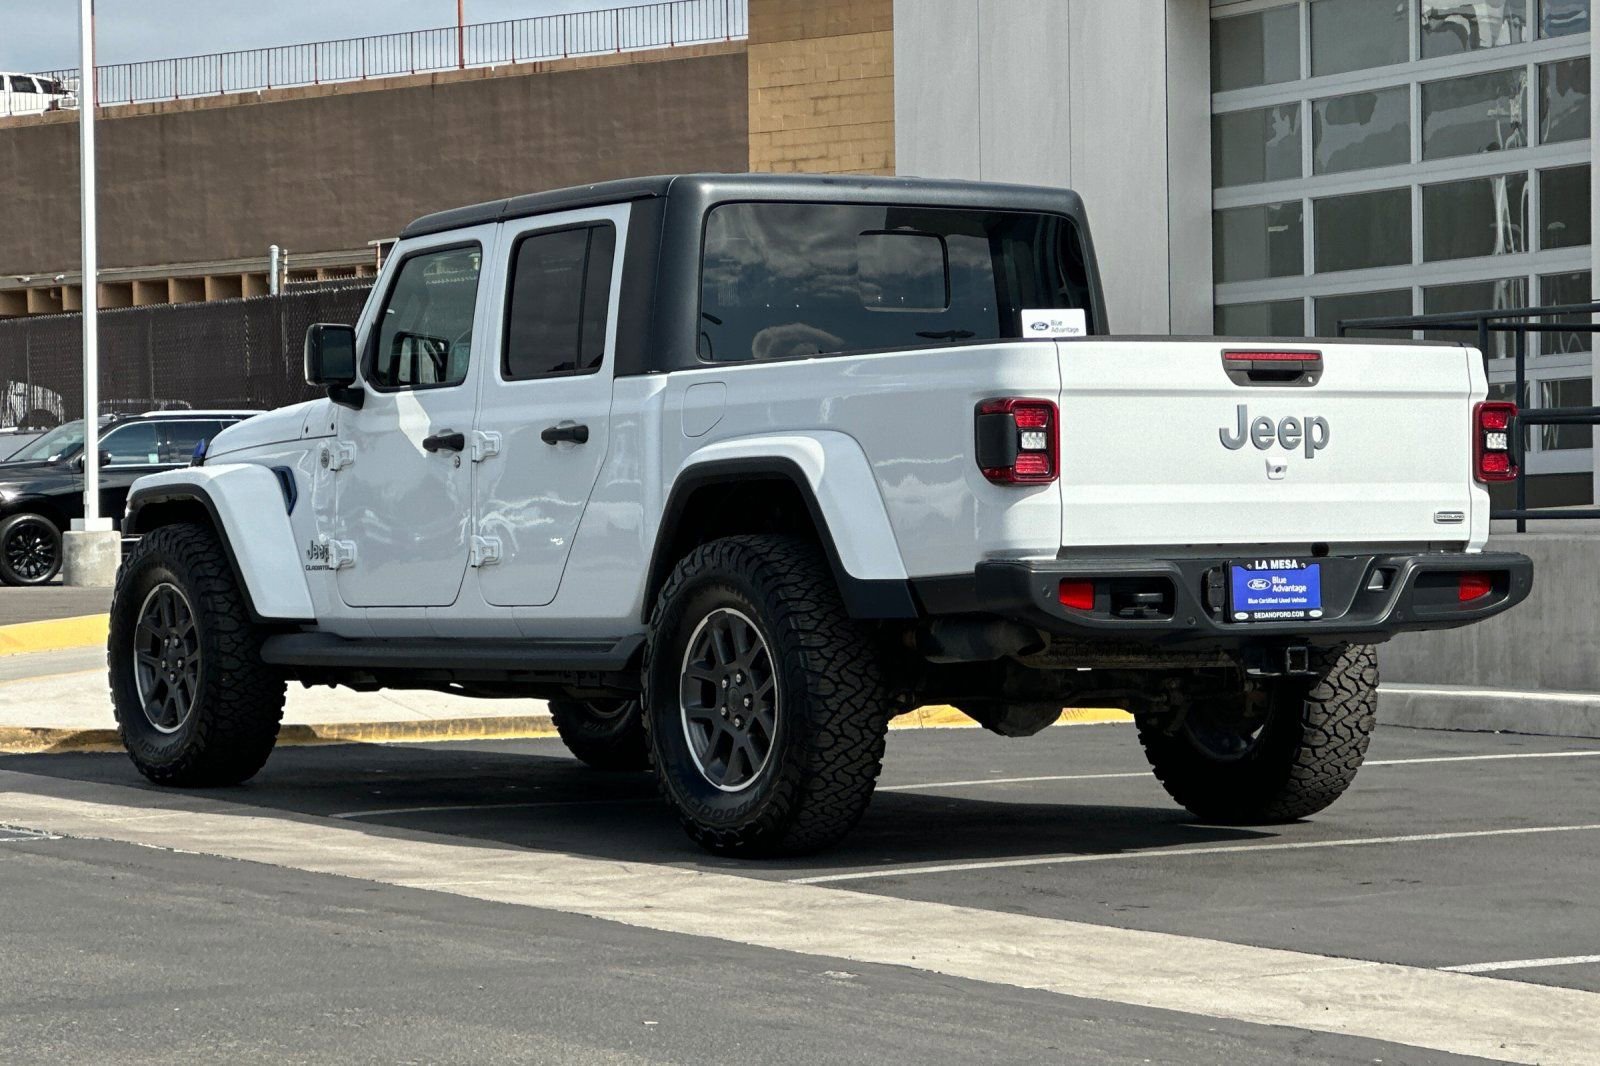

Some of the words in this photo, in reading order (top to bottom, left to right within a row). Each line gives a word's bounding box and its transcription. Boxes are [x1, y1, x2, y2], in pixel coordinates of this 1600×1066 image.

[1219, 404, 1330, 459] Jeep
[1255, 560, 1268, 570] LA
[1270, 560, 1298, 569] MESA
[1250, 580, 1268, 588] Ford
[1272, 584, 1306, 593] Advantage
